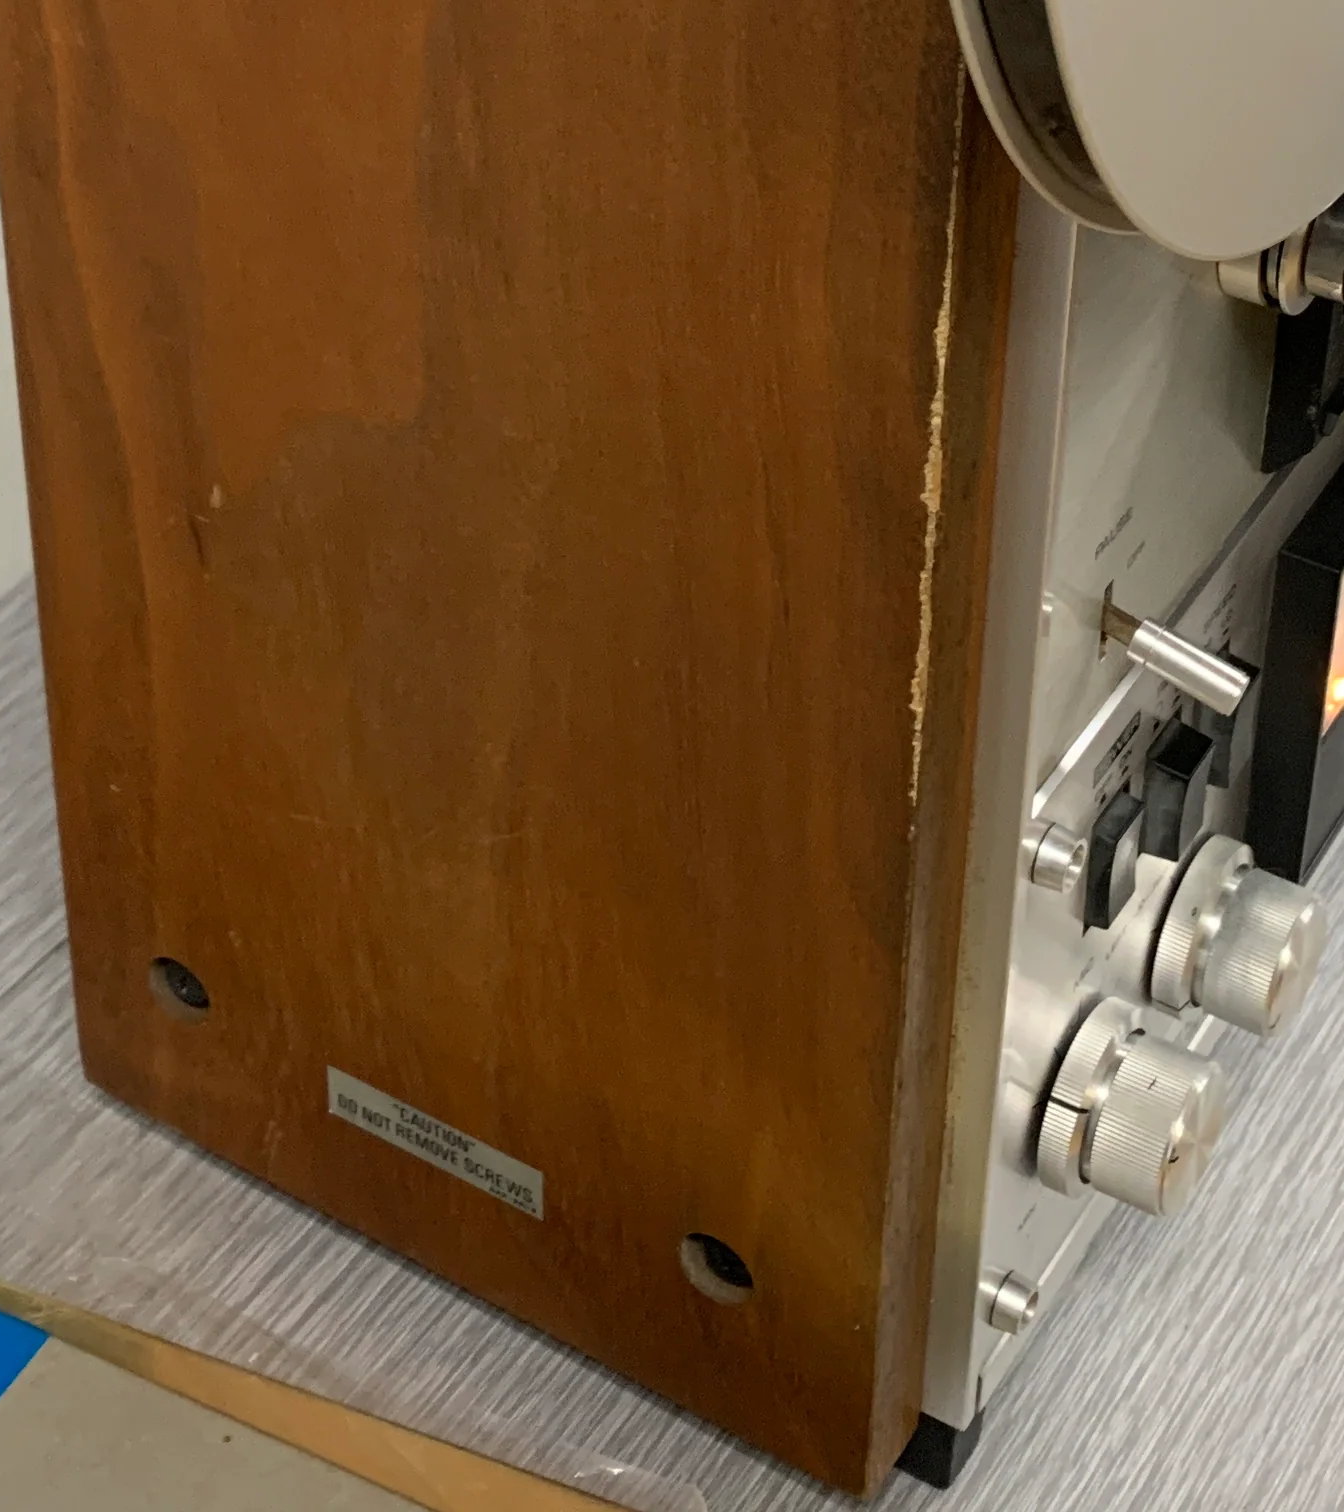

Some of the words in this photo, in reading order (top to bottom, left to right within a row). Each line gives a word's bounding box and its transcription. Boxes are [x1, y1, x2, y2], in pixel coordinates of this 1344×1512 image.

[362, 1106, 392, 1133] NOT
[396, 1123, 460, 1166] REMOVE
[464, 1156, 533, 1204] SCREWS
